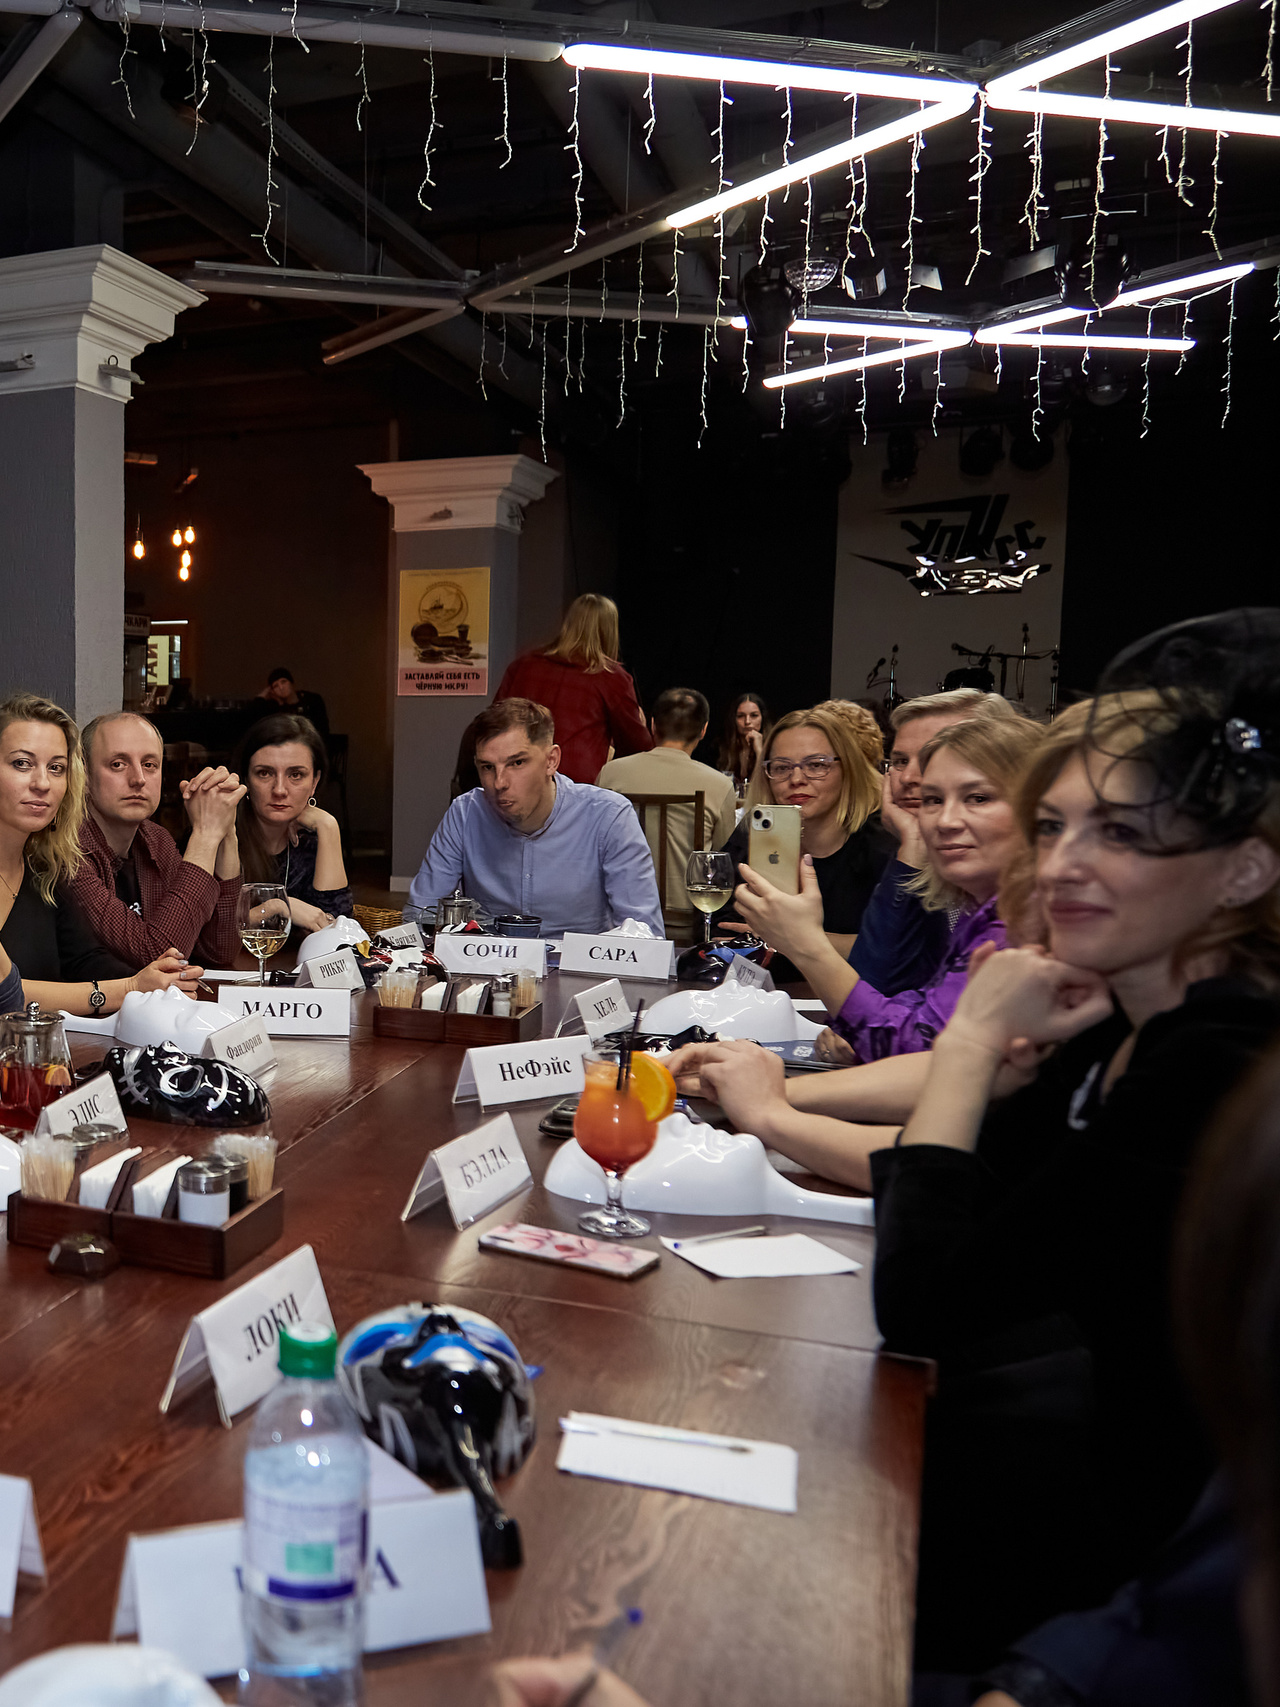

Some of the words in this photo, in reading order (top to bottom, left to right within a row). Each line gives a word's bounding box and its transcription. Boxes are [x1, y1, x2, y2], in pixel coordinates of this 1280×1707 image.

[405, 671, 444, 680] ЗАСТАВЛЯЙ
[446, 672, 462, 680] СЕБЯ
[463, 672, 480, 680] ЕСТЬ
[463, 943, 518, 958] СОЧИ
[588, 945, 638, 963] САРА
[241, 1000, 323, 1019] МАРГО
[593, 996, 618, 1020] ХЕЛЬ
[225, 1033, 263, 1060] Фандорин
[498, 1056, 573, 1081] НеФэйс
[68, 1093, 104, 1126] ЭЛИС
[459, 1145, 511, 1189] БЭЛЛА
[244, 1292, 302, 1362] ЛОКИ
